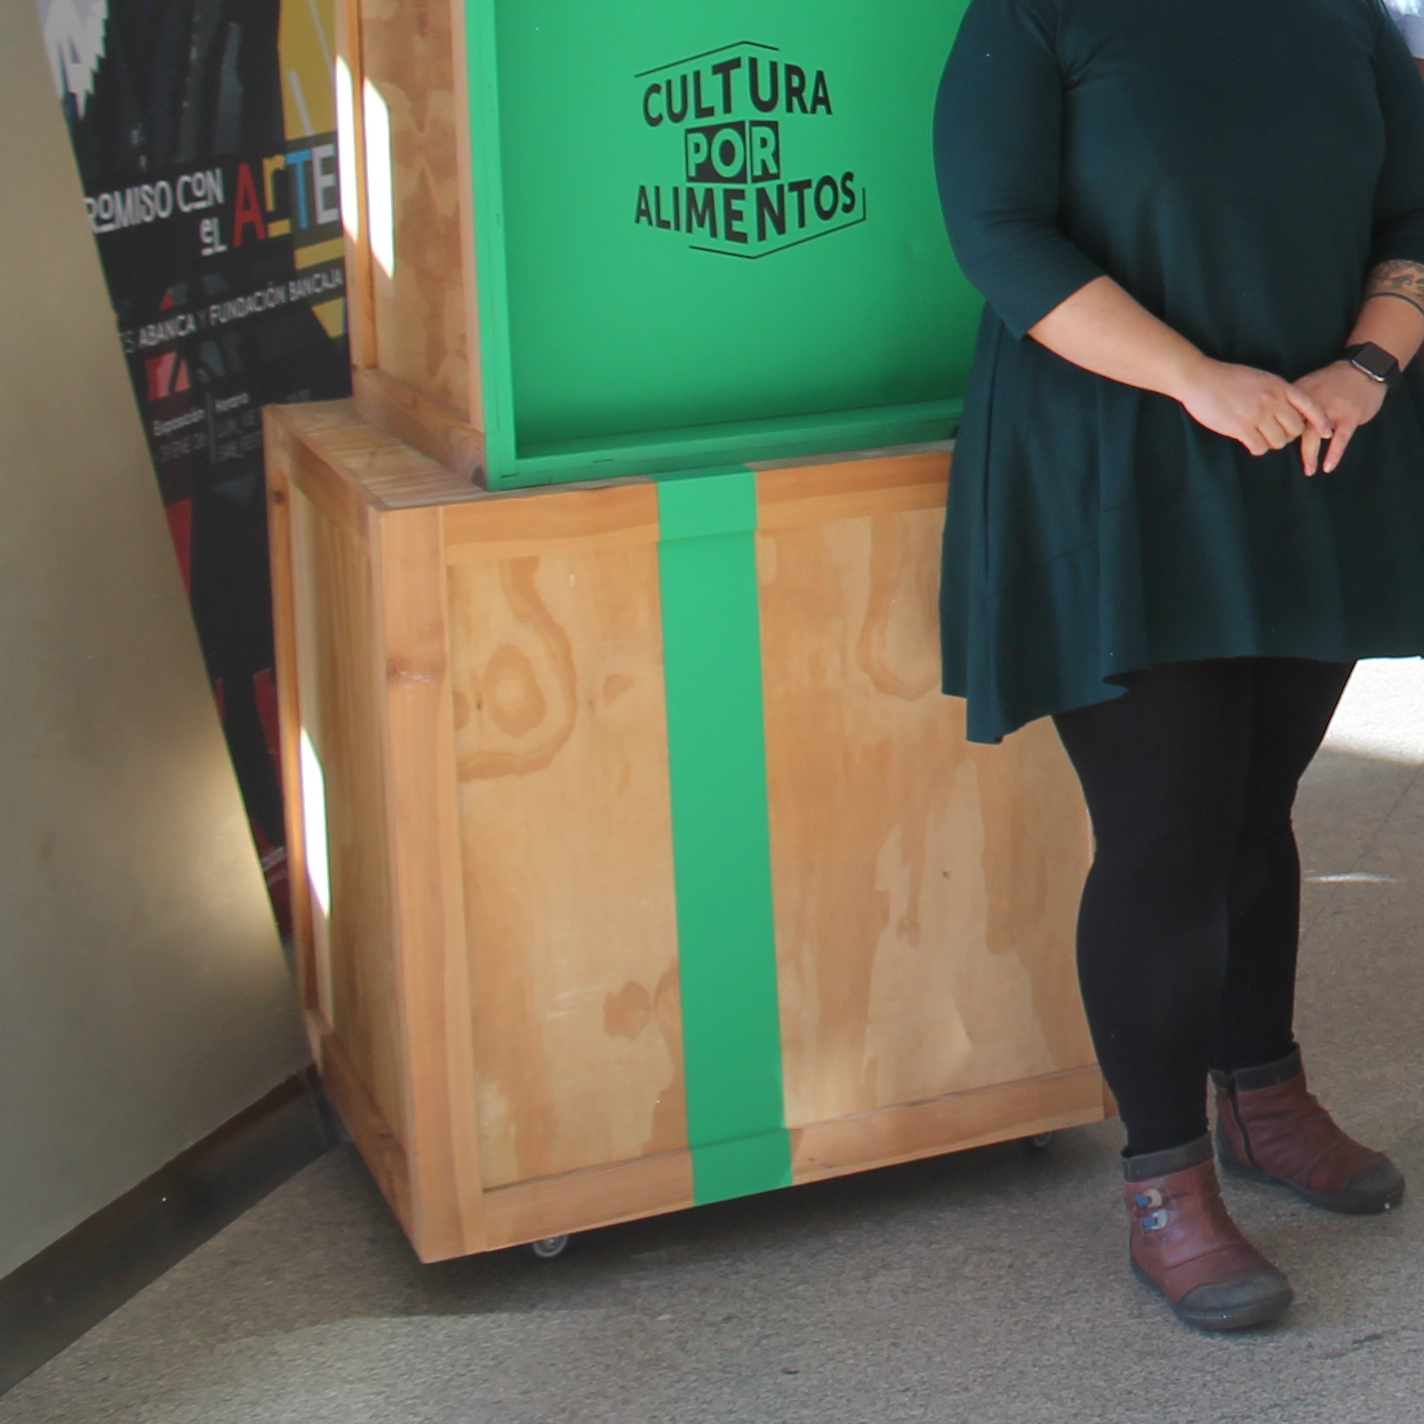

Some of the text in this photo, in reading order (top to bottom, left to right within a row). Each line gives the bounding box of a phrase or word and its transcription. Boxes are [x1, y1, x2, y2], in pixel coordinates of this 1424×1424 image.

[642, 56, 833, 127] CULTURA
[686, 122, 780, 183] POR
[634, 171, 856, 244] ALIMENTOS
[138, 313, 198, 348] ABANCA
[209, 280, 286, 326] FUNDACIÓN
[288, 268, 344, 302] BANCAJA
